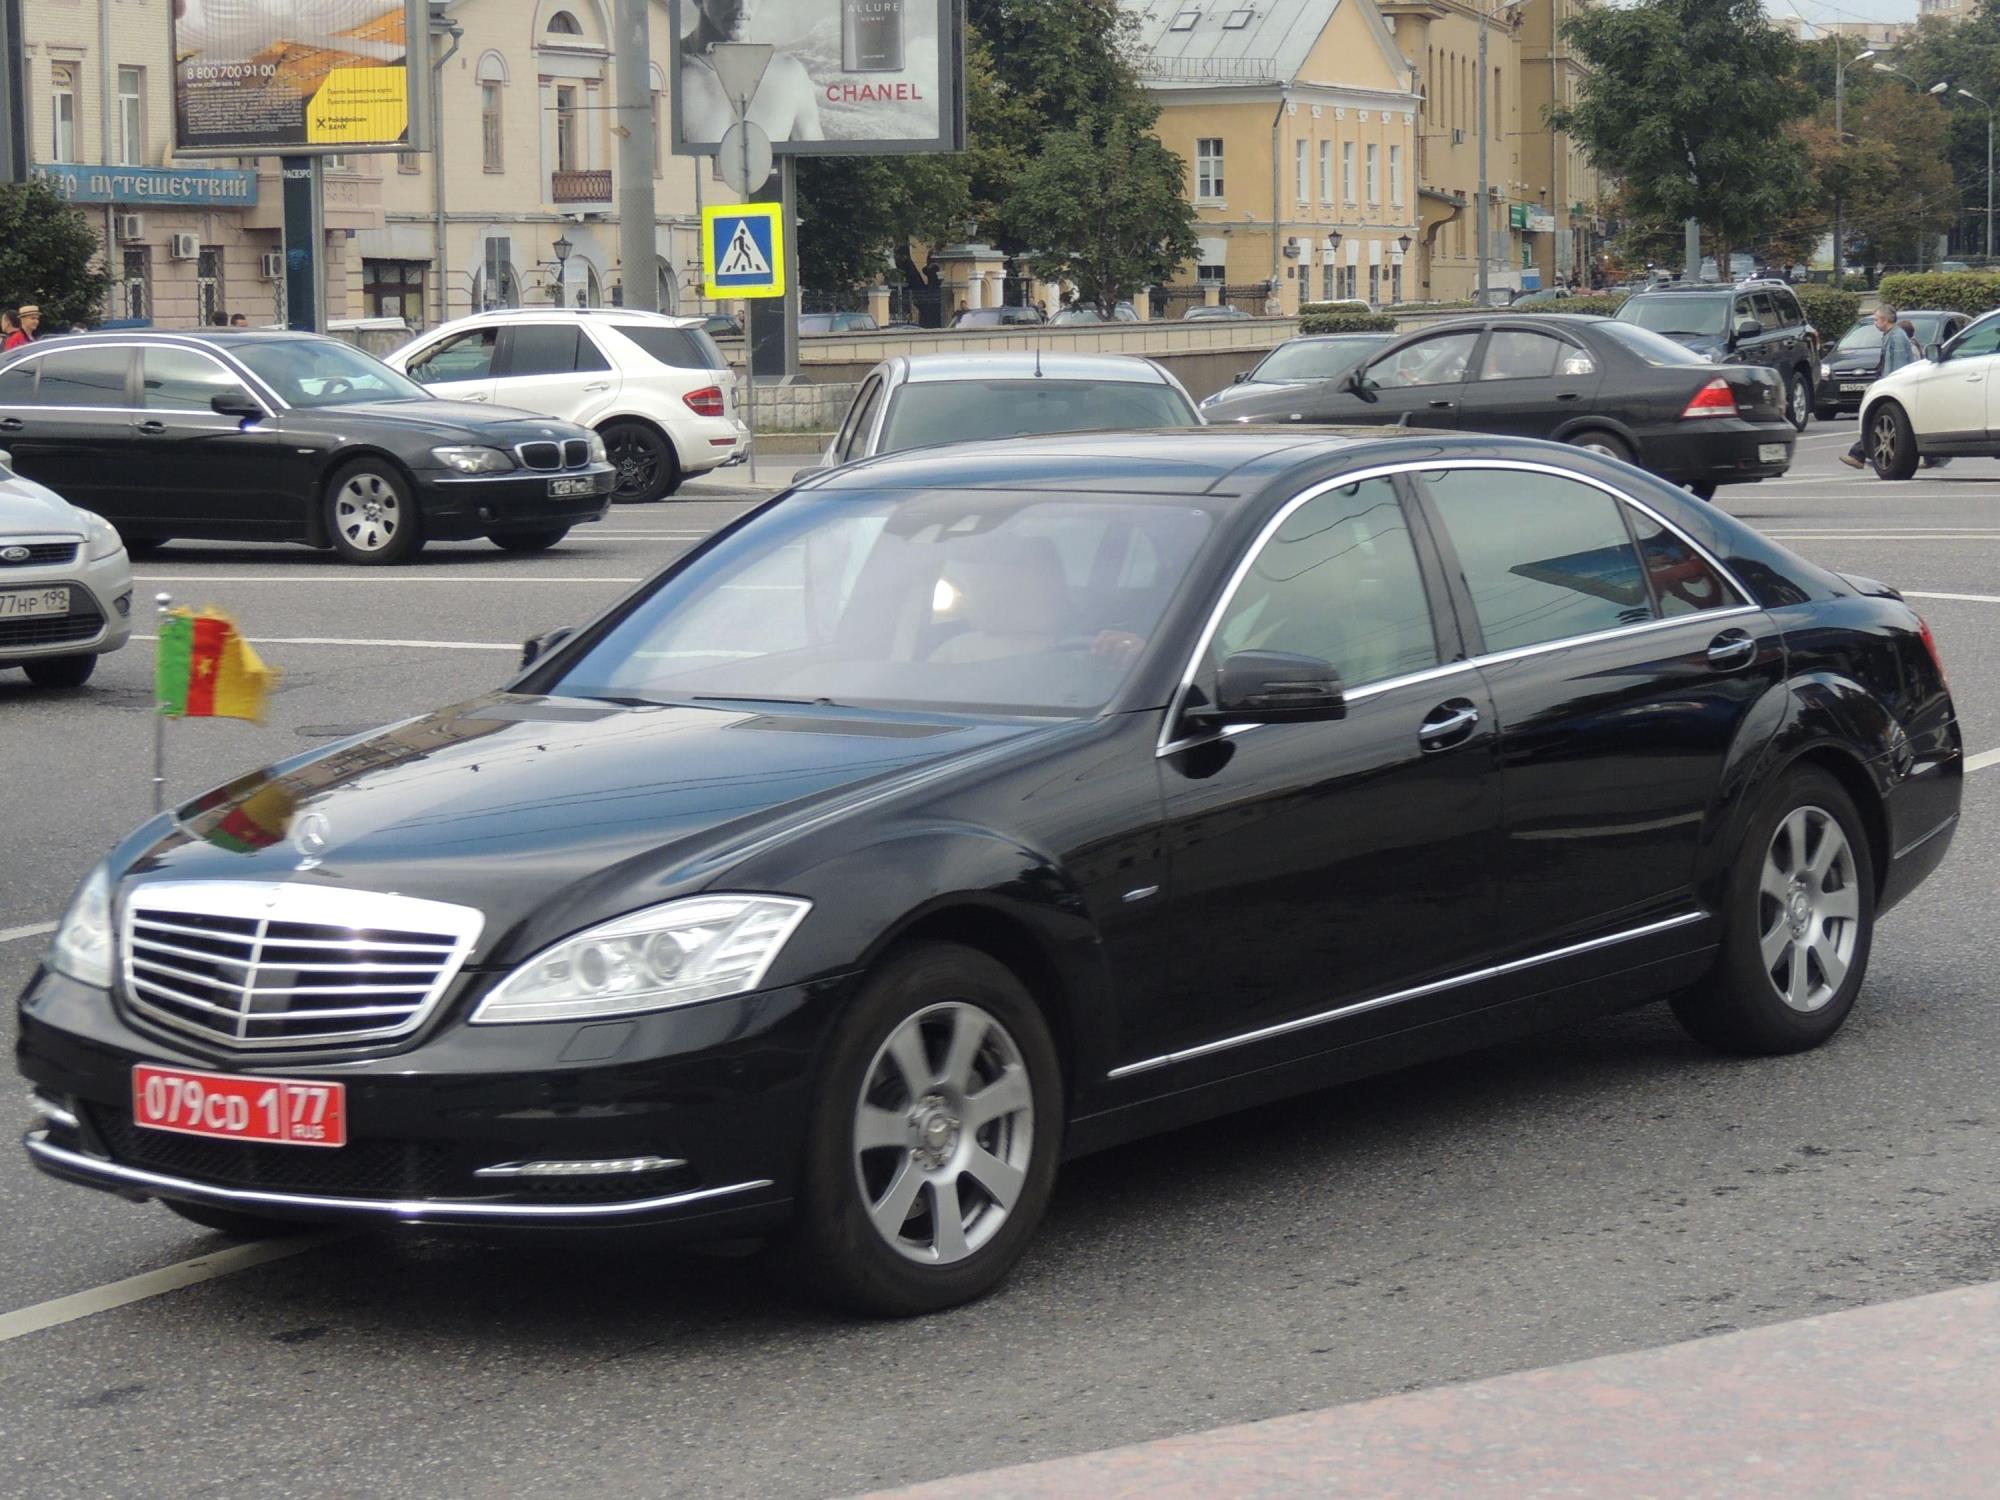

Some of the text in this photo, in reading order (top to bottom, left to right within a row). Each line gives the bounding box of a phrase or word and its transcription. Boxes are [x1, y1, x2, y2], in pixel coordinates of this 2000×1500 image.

[847, 3, 900, 13] ALLURE
[187, 64, 276, 79] 8 800 700 91 00
[826, 83, 923, 102] CHANEL
[288, 1087, 329, 1124] 77
[292, 1124, 325, 1139] RUS
